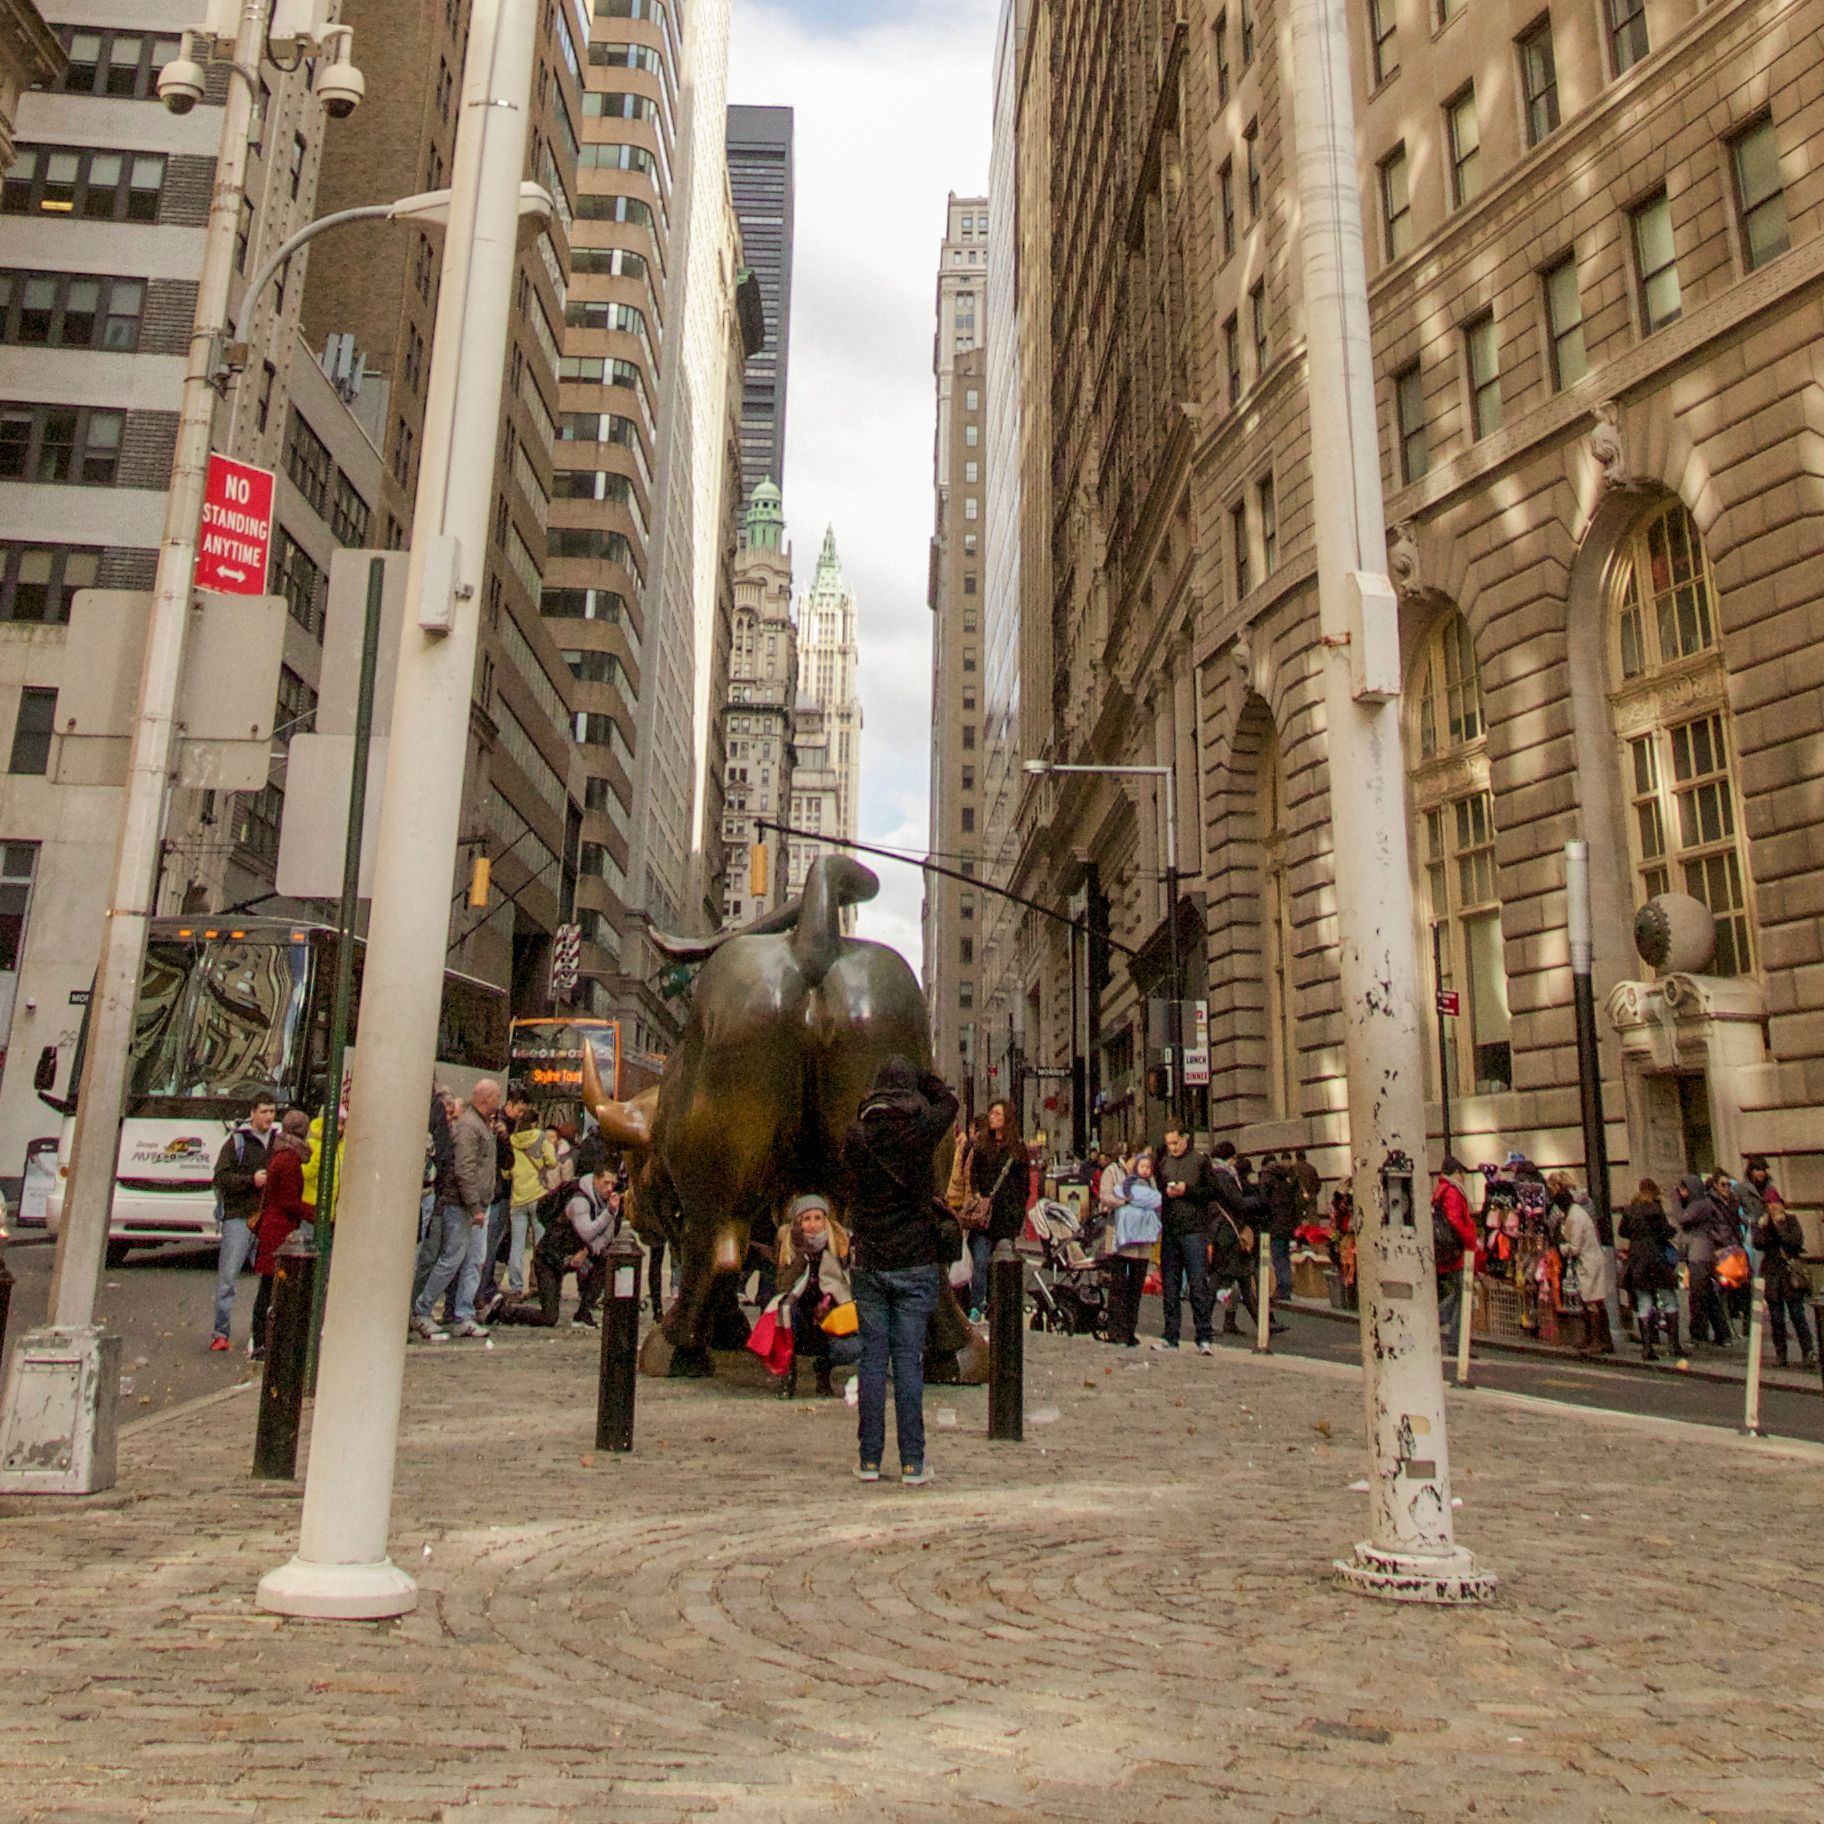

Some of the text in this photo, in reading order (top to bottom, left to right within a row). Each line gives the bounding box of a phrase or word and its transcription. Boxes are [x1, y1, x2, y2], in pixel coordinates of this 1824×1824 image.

[225, 474, 250, 505] NO
[202, 502, 268, 540] STANDING
[202, 533, 262, 568] ANYTIME
[71, 994, 90, 1002] MO
[1186, 1055, 1207, 1065] LUNCH
